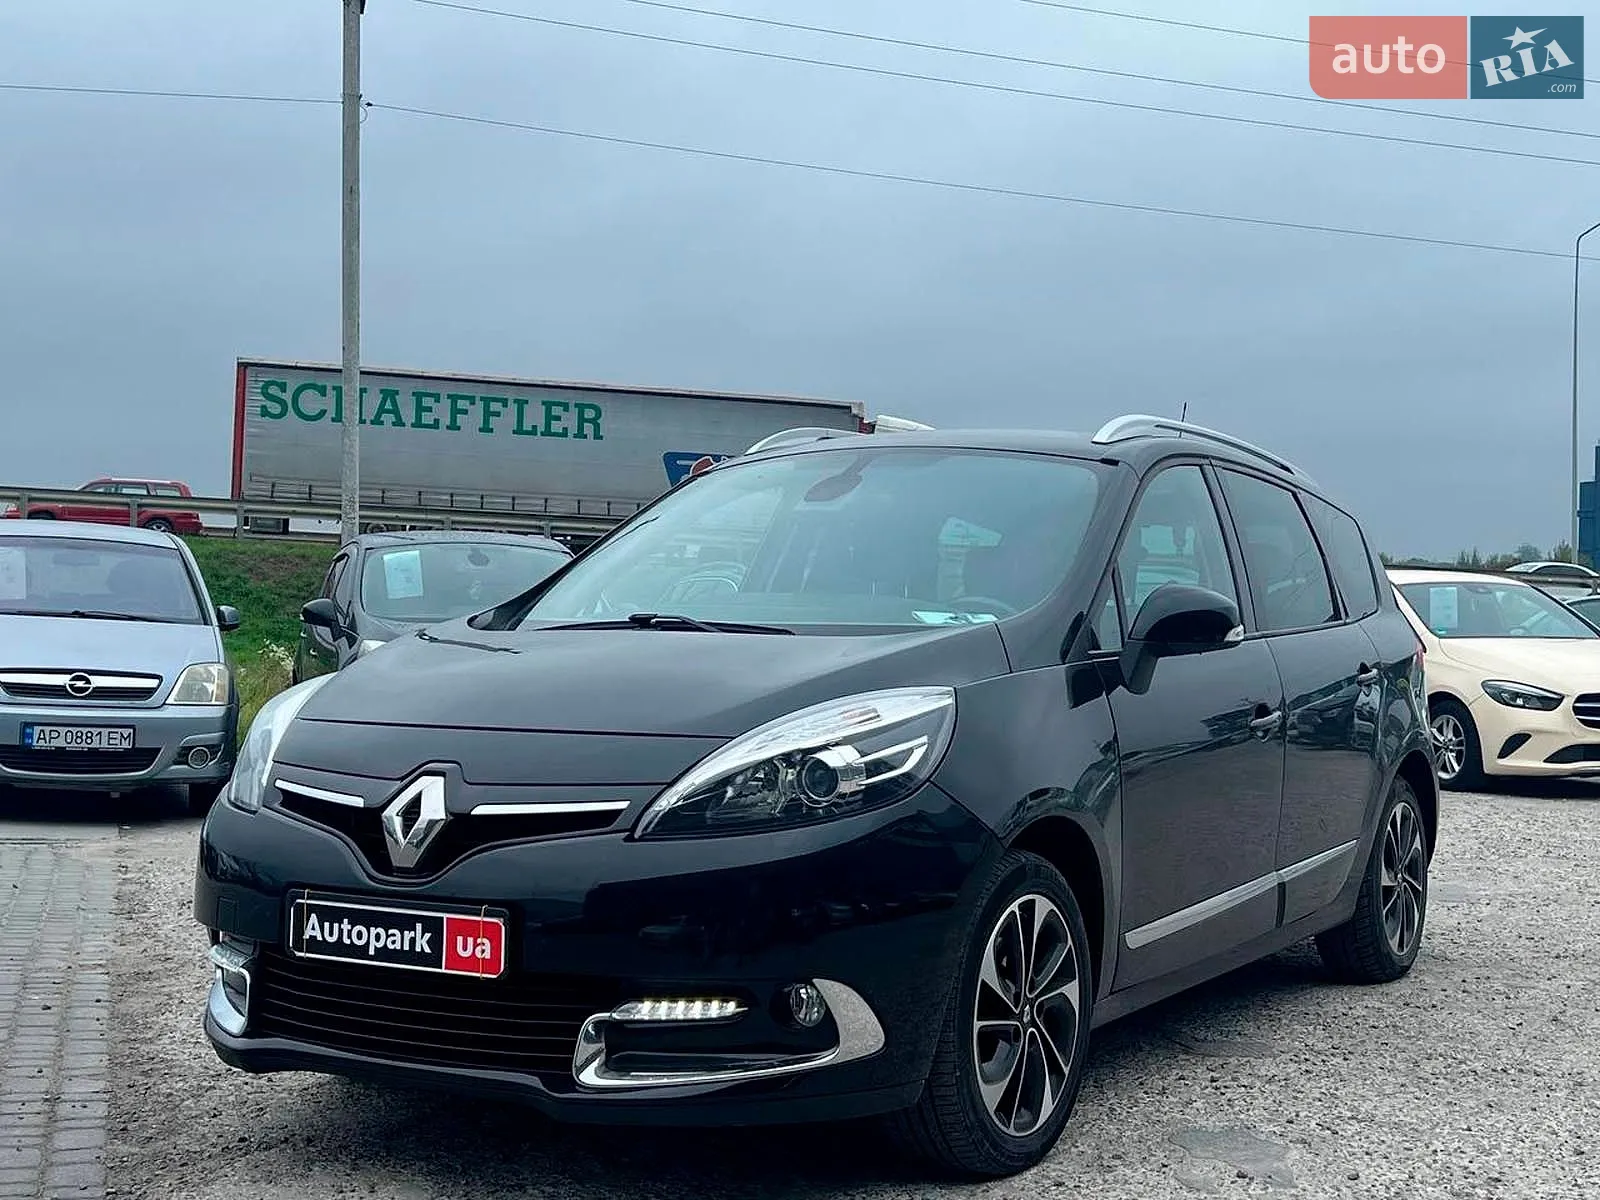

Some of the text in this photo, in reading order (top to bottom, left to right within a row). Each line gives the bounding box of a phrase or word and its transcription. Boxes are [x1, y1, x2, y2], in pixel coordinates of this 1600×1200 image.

[260, 379, 604, 441] SCHAEFFLER
[35, 729, 132, 747] AP 0881 EM
[304, 912, 491, 960] Autopark ua
